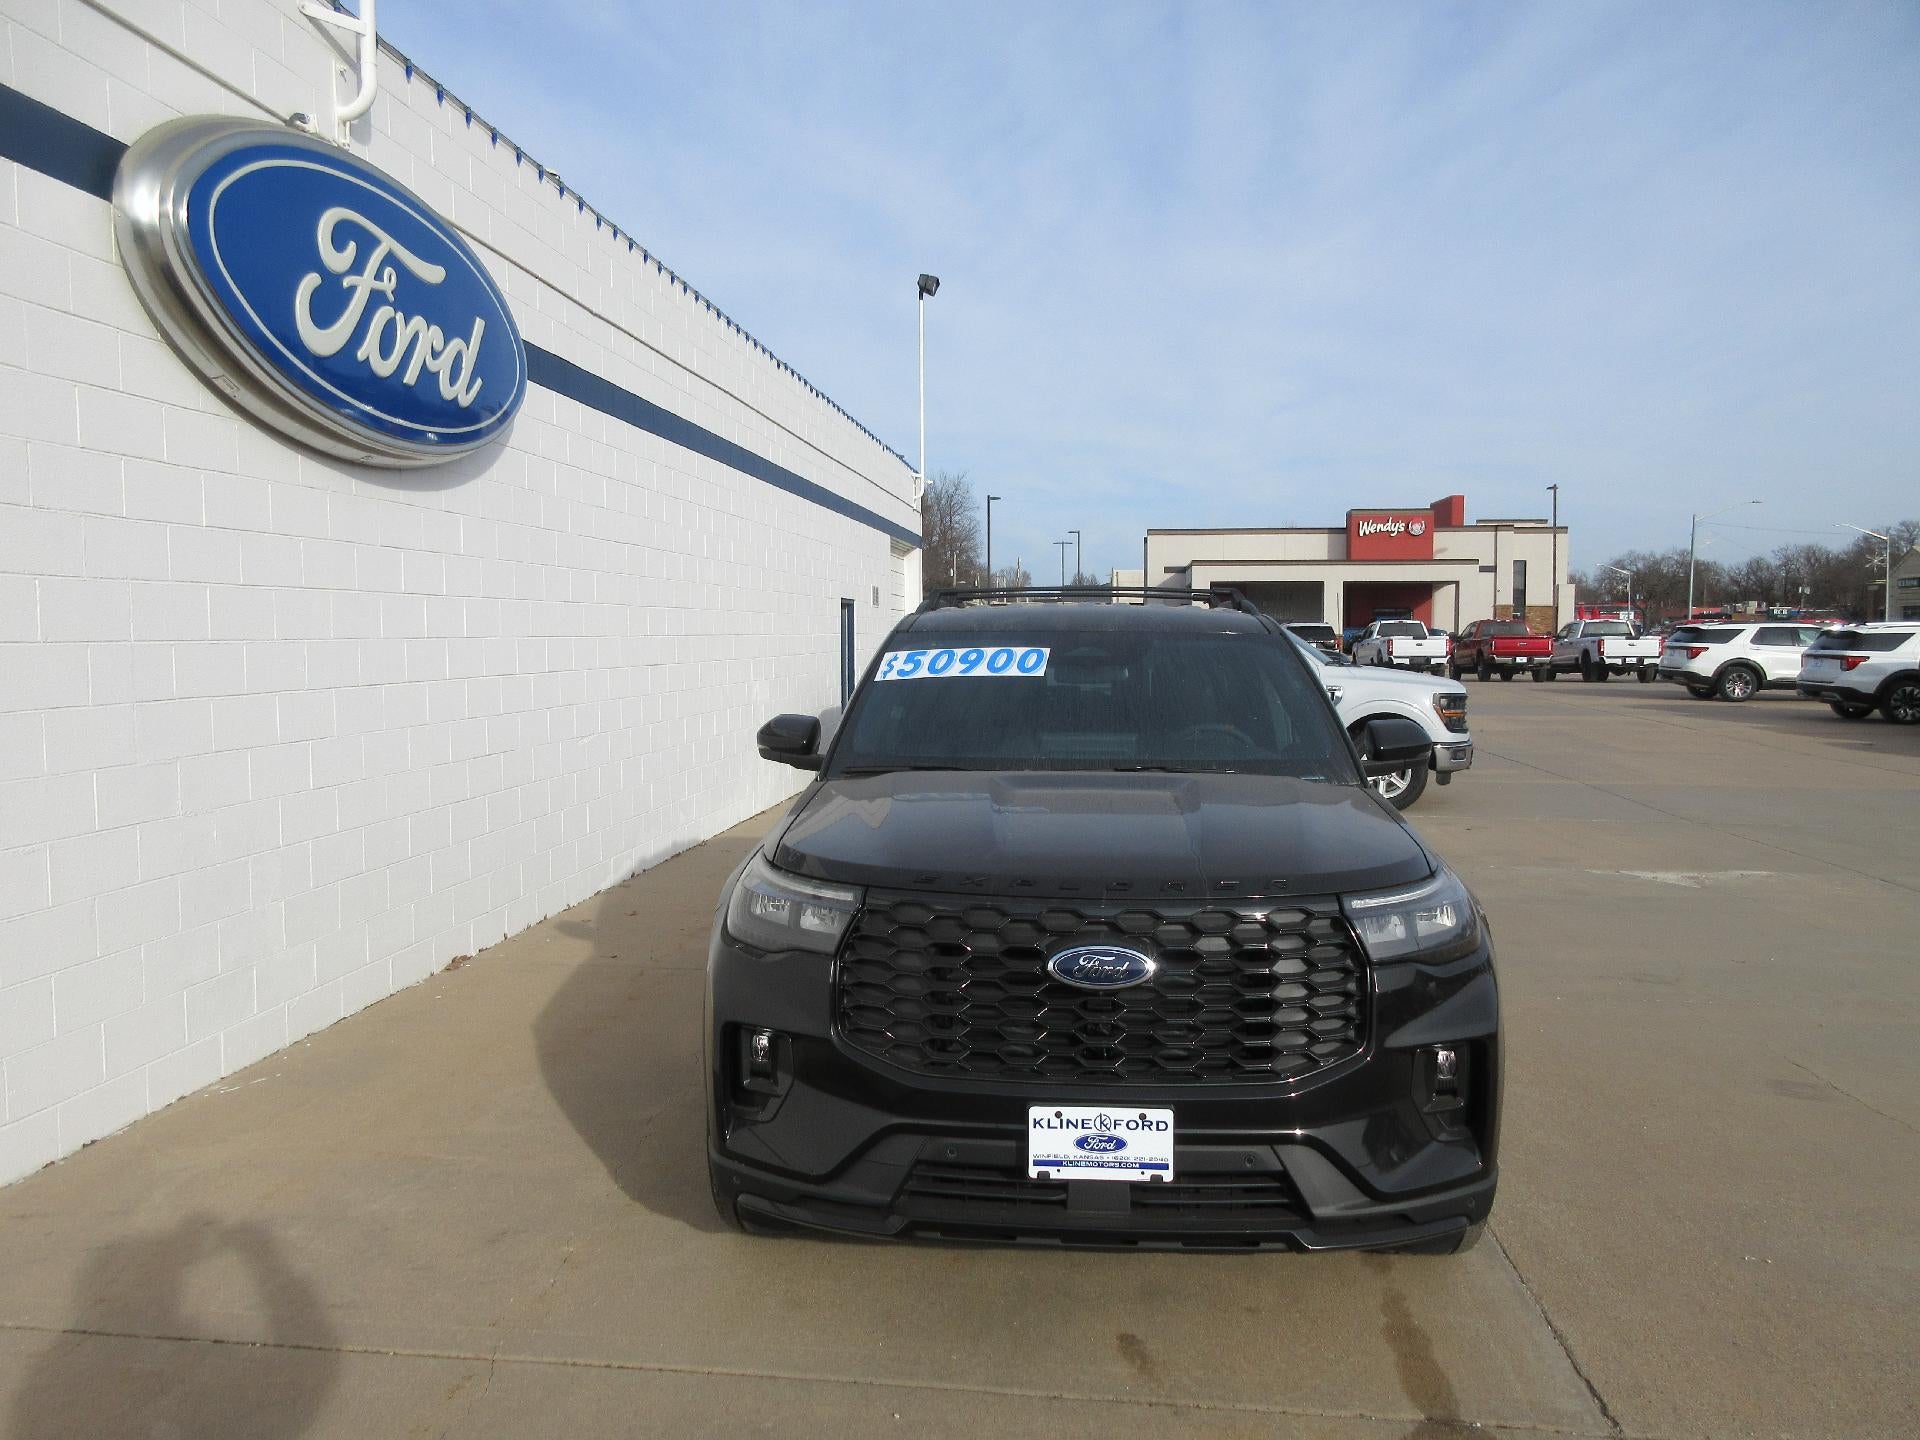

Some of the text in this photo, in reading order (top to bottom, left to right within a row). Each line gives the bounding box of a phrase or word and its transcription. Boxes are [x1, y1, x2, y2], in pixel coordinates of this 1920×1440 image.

[295, 206, 485, 408] Ford
[1359, 516, 1406, 537] Wendy's
[880, 648, 1046, 680] $50900
[1072, 954, 1130, 979] Ford
[1032, 1117, 1093, 1130] KLINE
[1113, 1119, 1169, 1132] FORD
[1083, 1135, 1118, 1150] Ford
[1062, 1160, 1140, 1168] KLINEMOTORS.COM
